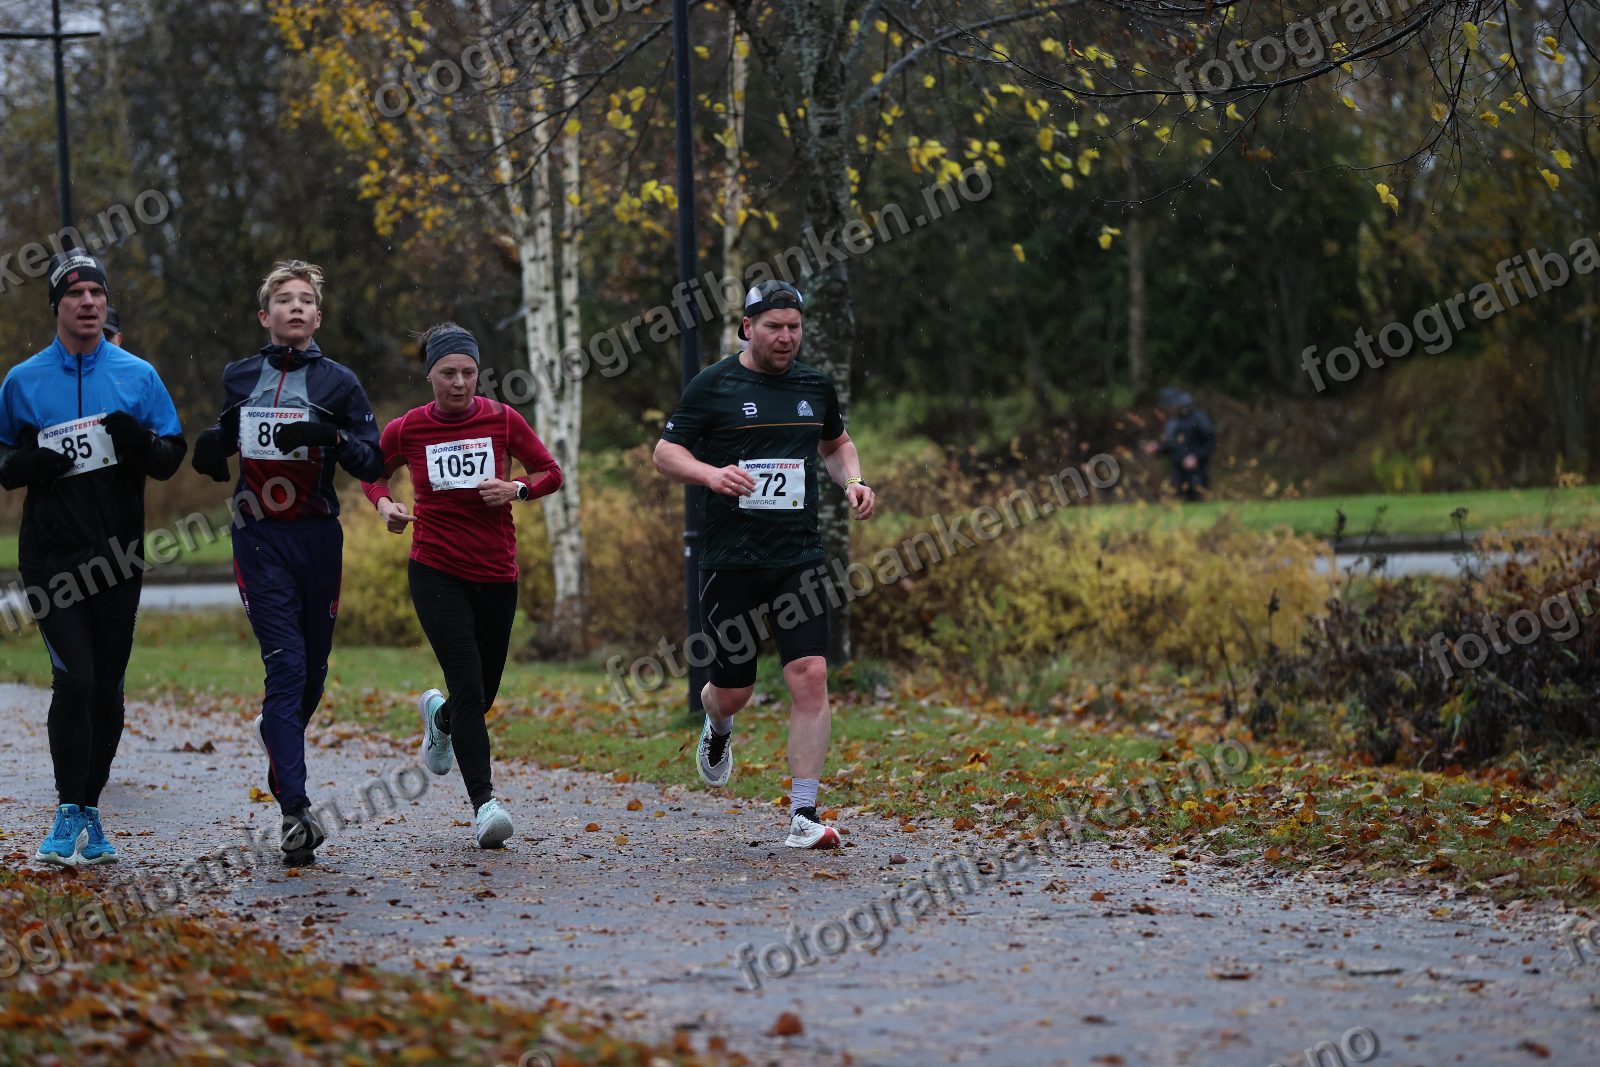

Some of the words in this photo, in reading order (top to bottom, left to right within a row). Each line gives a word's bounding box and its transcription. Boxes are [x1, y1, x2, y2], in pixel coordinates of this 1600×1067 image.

[247, 406, 304, 419] NORGESTESTEN
[61, 433, 92, 463] 85
[432, 441, 488, 454] NORGESTESTEN
[434, 451, 488, 478] 1057
[759, 472, 787, 497] 72
